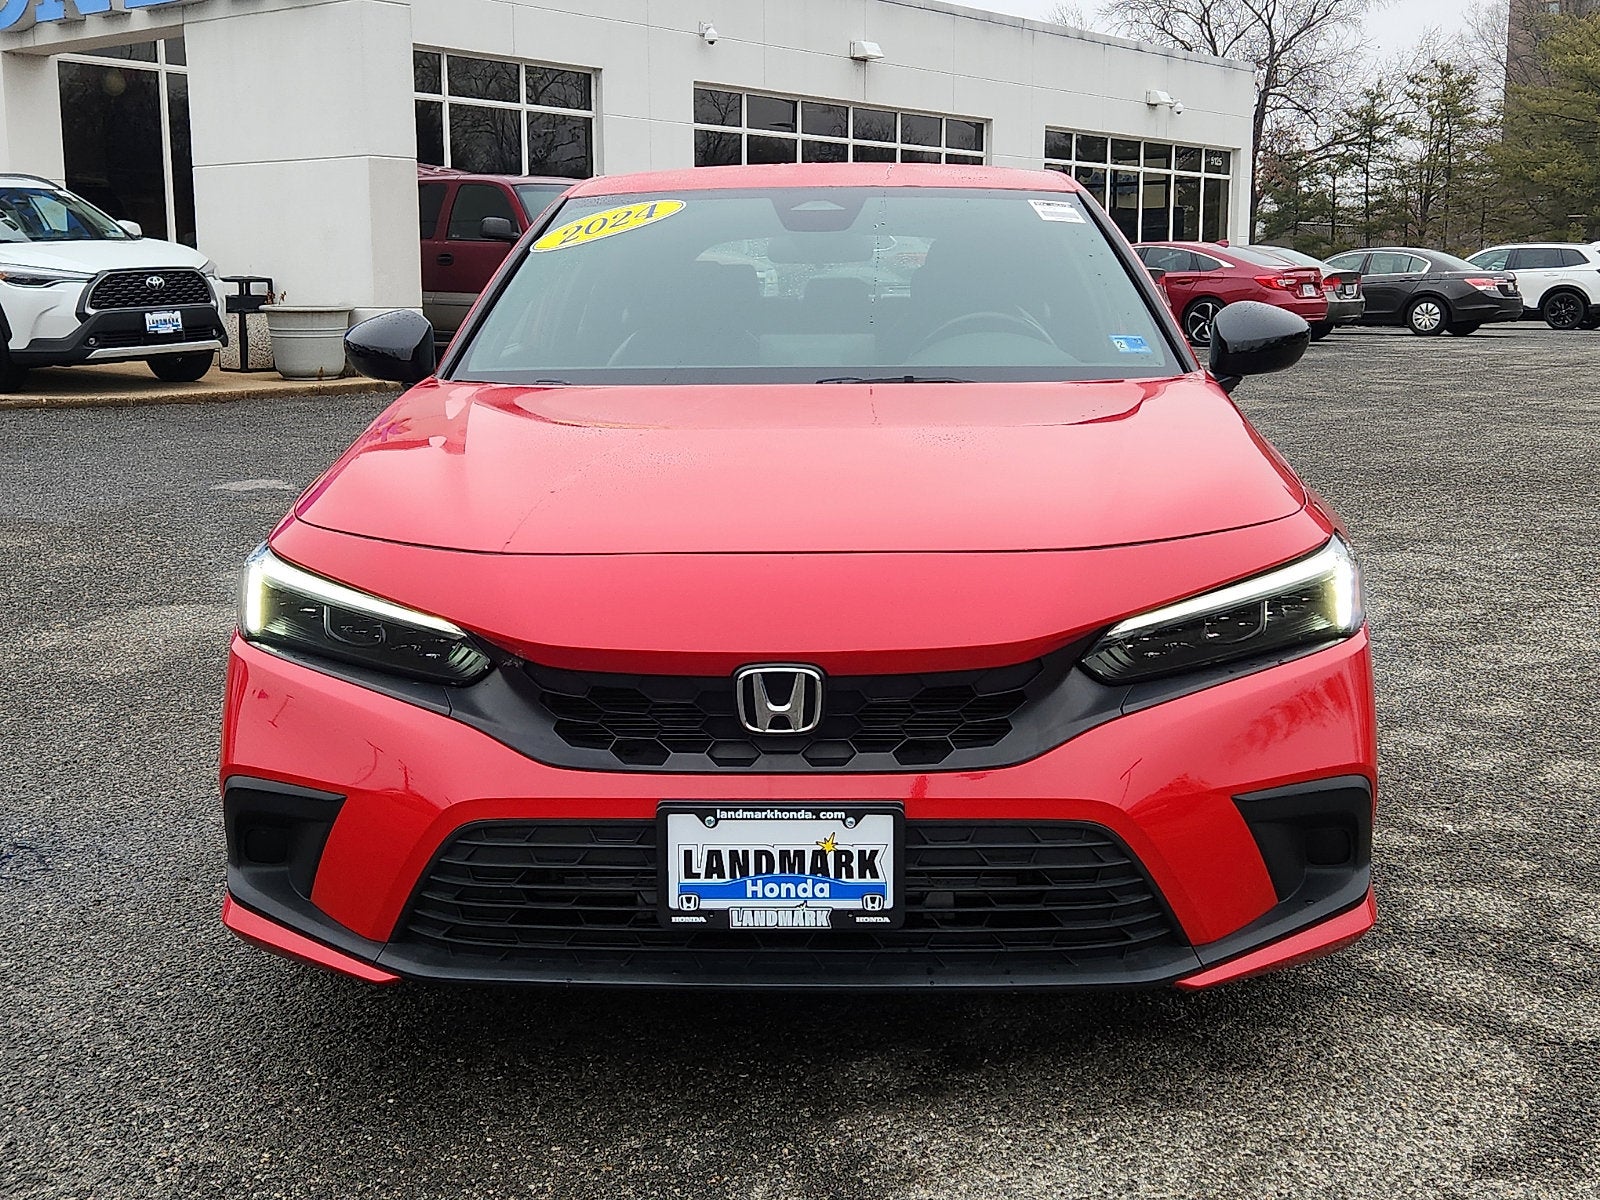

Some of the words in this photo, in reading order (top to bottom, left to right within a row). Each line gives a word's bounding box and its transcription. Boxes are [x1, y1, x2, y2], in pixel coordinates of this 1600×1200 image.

[558, 203, 658, 246] 2024
[683, 848, 880, 880] LANDMARK
[746, 878, 831, 899] Honda
[731, 910, 830, 927] LANDMARK
